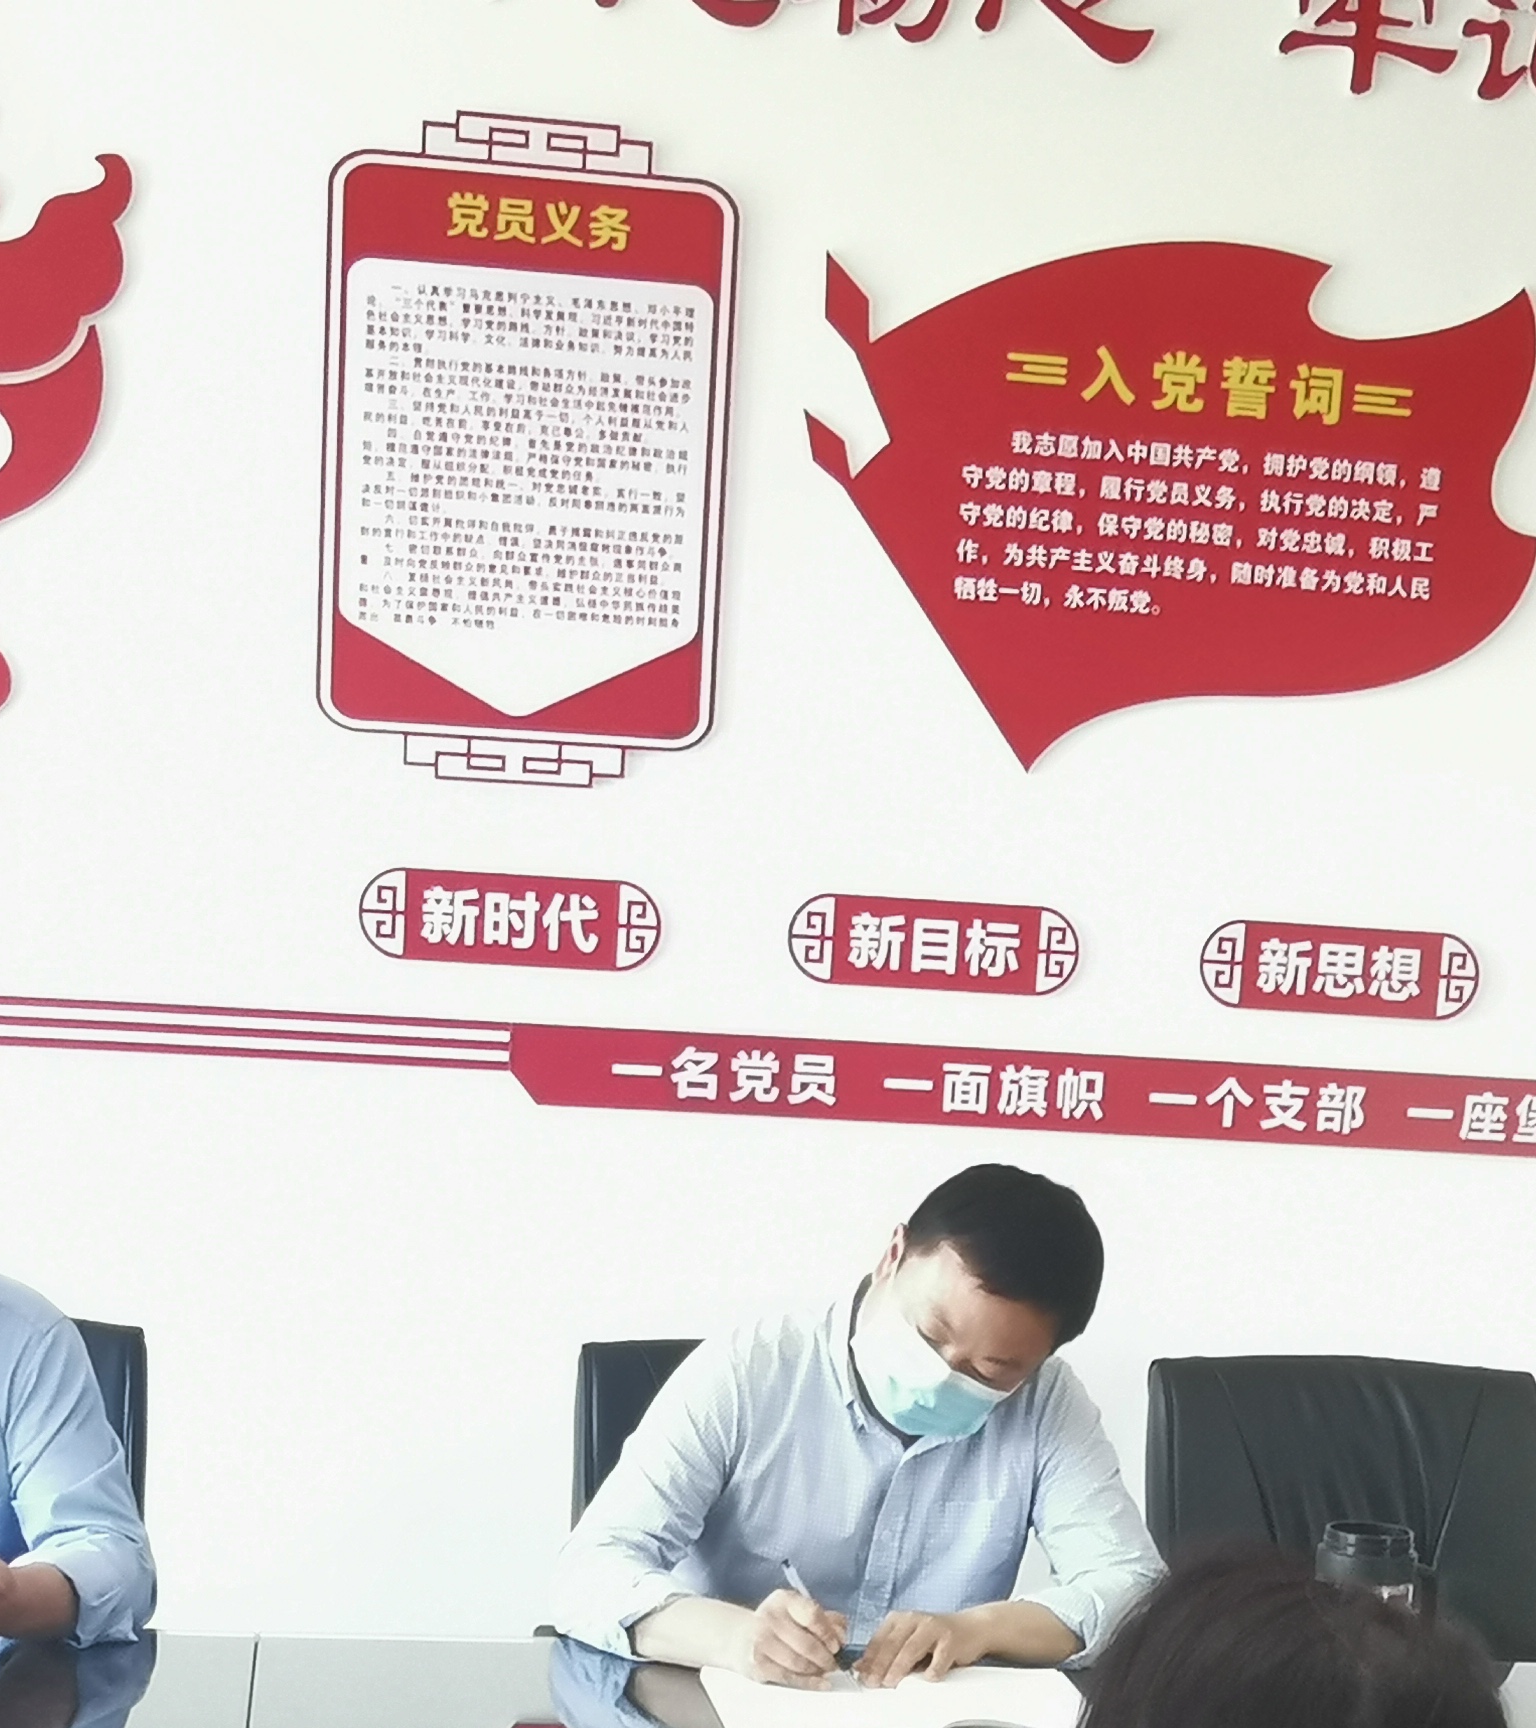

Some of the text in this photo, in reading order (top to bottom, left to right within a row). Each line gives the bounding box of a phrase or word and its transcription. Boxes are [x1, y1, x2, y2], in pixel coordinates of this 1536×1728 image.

[446, 191, 631, 251] 党员义务
[1081, 346, 1345, 424] 入党誓词
[1010, 430, 1442, 491] 我志愿加入中国共产党，拥护党的纲领，遵
[962, 464, 1438, 525] 守党的章程，履行党员义务，执行党的决定，严
[959, 501, 1434, 563] 守党的纪律，保守党的秘密，对党忠诚，积极工
[954, 576, 1162, 616] 牺牲一切，永不叛党。
[956, 538, 1431, 600] 作，为共产主义奋斗终身，随时准备为党和人民
[420, 885, 601, 954] 新时代
[848, 912, 1022, 978] 新目标
[1255, 936, 1423, 1003] 新思想
[611, 1045, 838, 1106] 一名党员
[883, 1062, 1107, 1122] 一面旗帜
[1148, 1077, 1367, 1136] 一个支部
